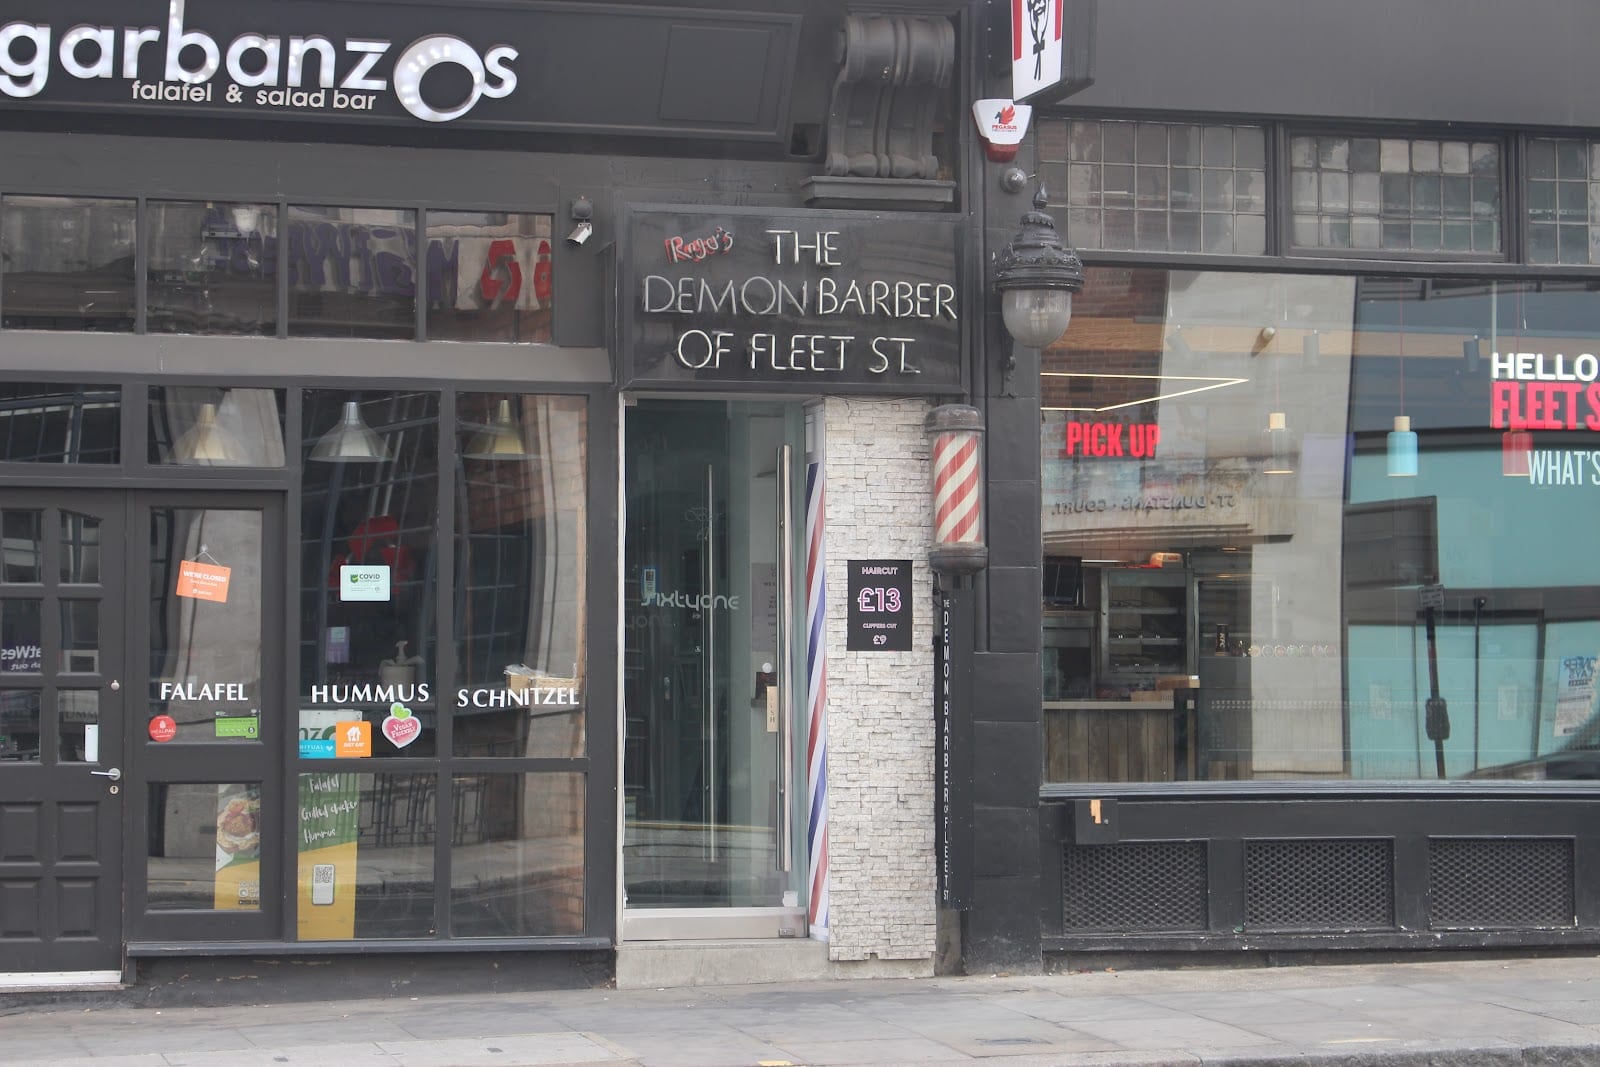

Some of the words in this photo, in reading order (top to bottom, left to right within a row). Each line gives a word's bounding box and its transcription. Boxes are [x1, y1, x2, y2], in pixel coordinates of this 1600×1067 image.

[0, 0, 520, 123] garbanzos
[132, 79, 213, 103] falafel
[225, 83, 244, 104] &
[256, 86, 326, 109] salad
[332, 89, 377, 111] bar
[765, 229, 842, 266] THE
[643, 275, 808, 315] DEMON
[817, 277, 957, 320] BARBER
[678, 329, 735, 370] OF
[747, 333, 856, 371] FLEET
[1490, 352, 1599, 381] HELLO
[1490, 381, 1583, 430] FLEET
[1066, 421, 1123, 458] PICK
[1130, 423, 1161, 458] UP
[1526, 450, 1600, 486] WHAT'S
[202, 573, 227, 583] CLOSED
[861, 566, 899, 575] HAIRCUT
[857, 587, 902, 613] £13
[872, 634, 887, 645] £9
[160, 683, 248, 702] FALAFEL
[311, 683, 430, 704] HUMMUS
[457, 687, 580, 708] SCHNITZEL
[309, 773, 340, 794] Falafel
[301, 804, 329, 821] Grilled
[303, 828, 336, 844] Hummus
